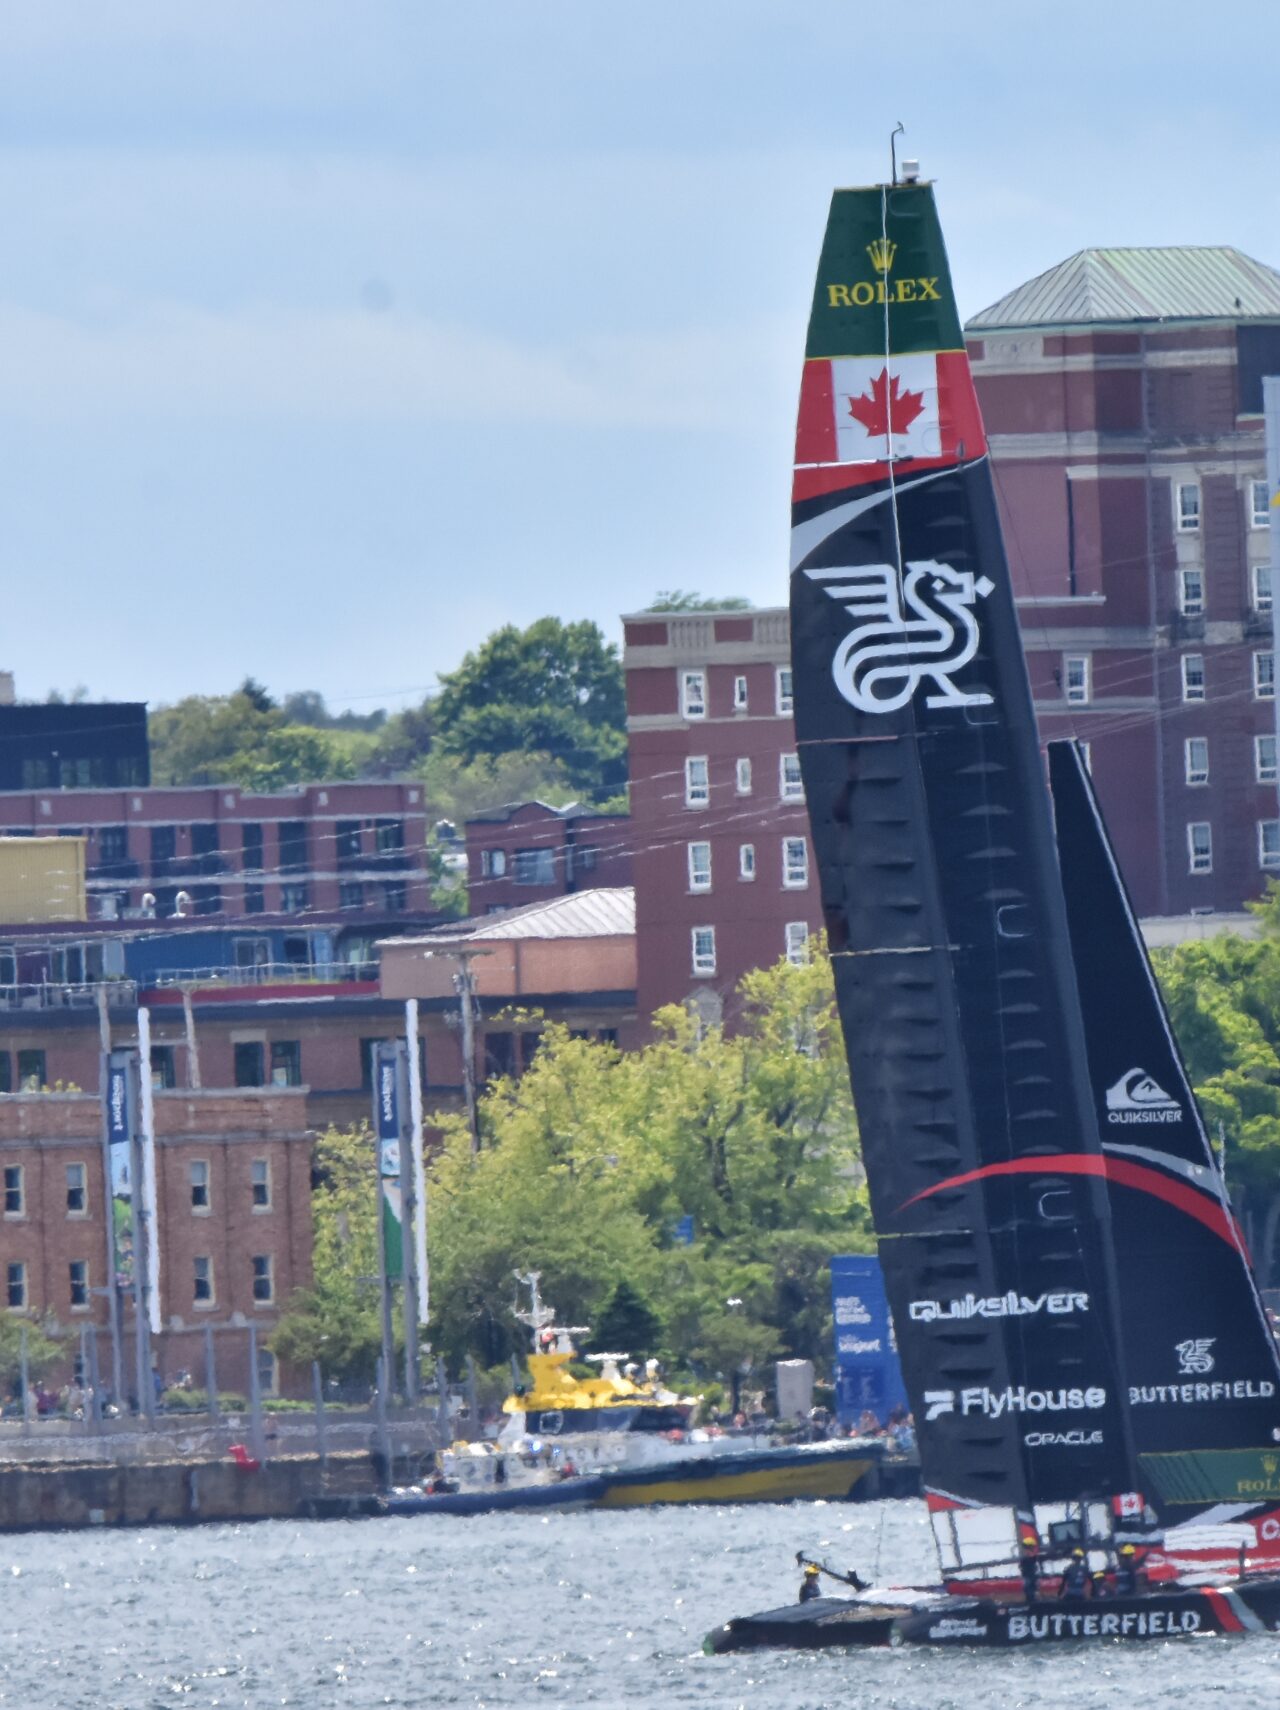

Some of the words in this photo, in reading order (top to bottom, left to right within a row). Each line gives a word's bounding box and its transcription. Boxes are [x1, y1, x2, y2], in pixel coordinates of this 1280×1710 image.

[827, 277, 941, 307] ROLEX
[1107, 1110, 1182, 1124] QUIKSILVER
[961, 1386, 1106, 1419] FlyHouse
[1128, 1380, 1275, 1405] BUTTERFIELD
[1025, 1430, 1104, 1447] ORACLE
[1008, 1609, 1201, 1641] BUTTERFIELD
